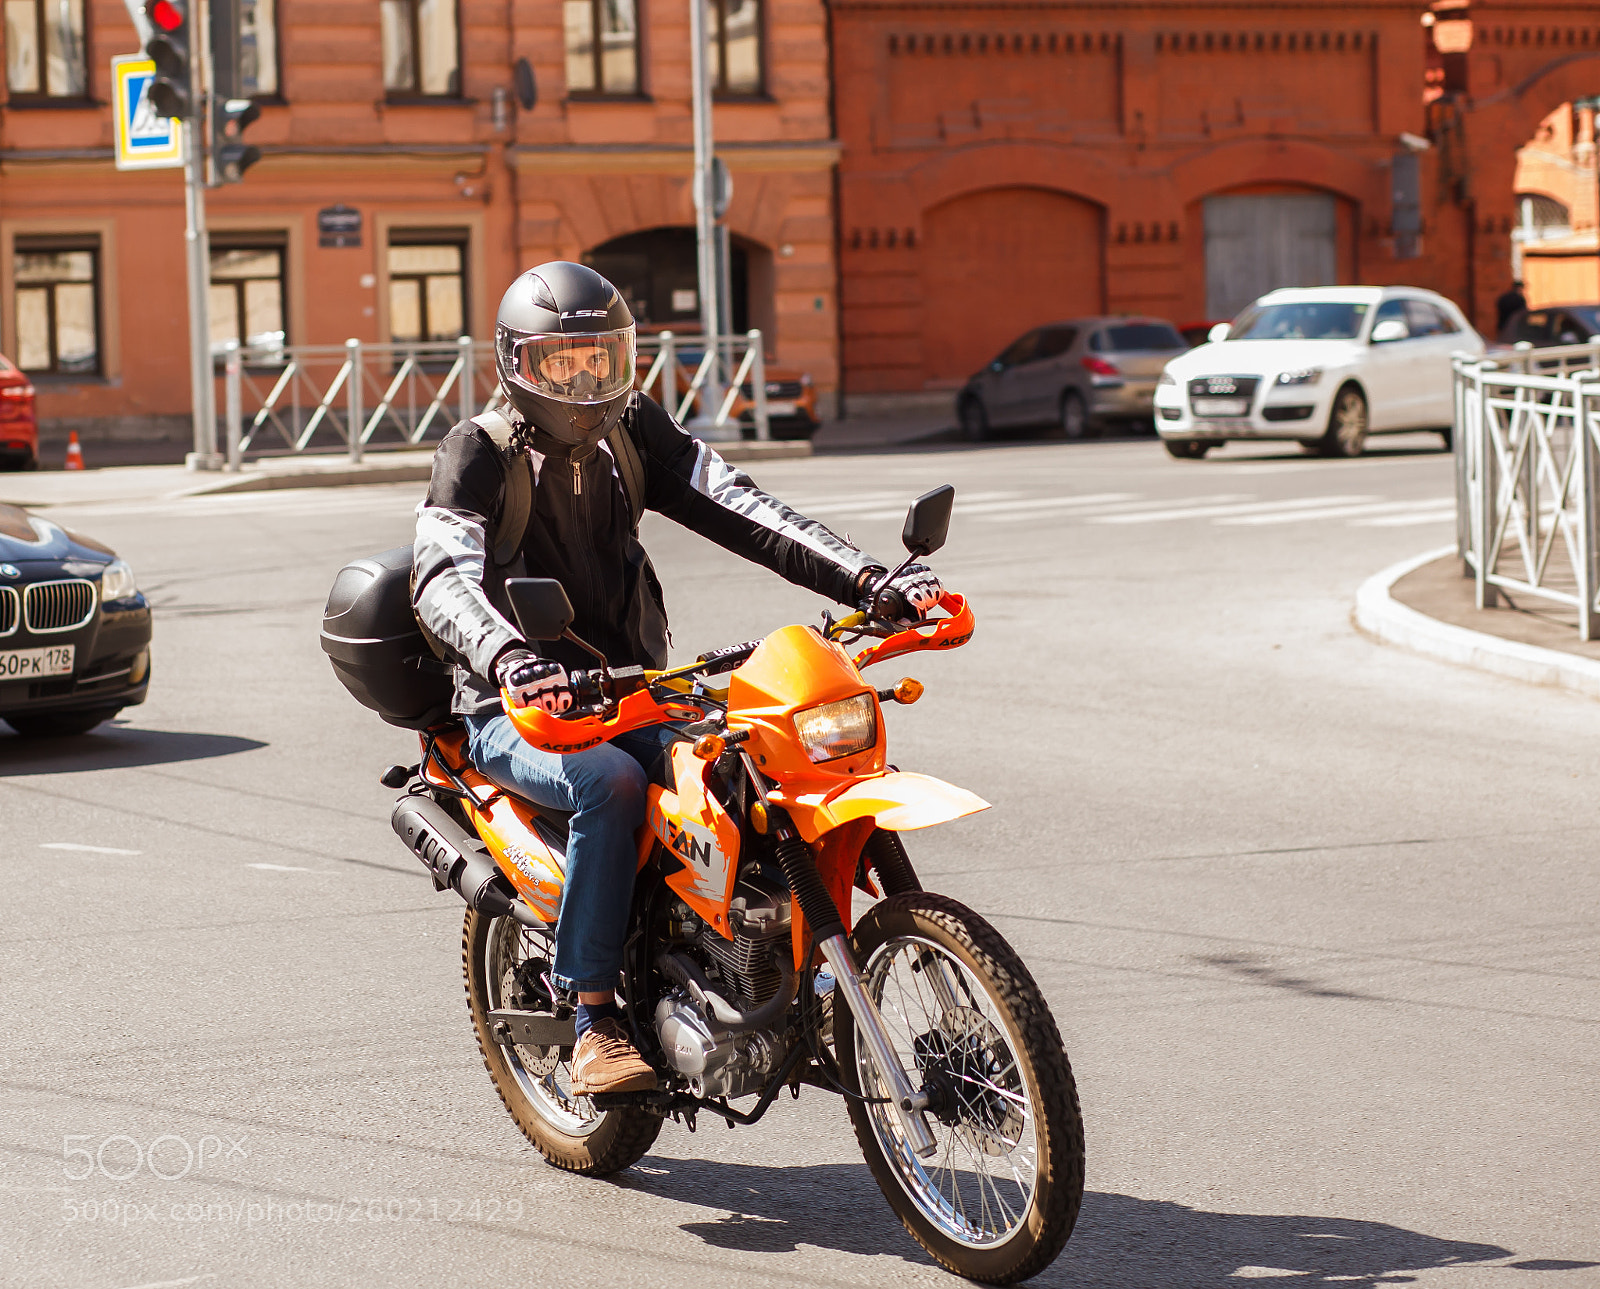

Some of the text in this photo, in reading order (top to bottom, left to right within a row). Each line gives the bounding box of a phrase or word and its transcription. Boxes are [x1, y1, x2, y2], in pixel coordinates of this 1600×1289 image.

[561, 309, 608, 320] LS2
[46, 648, 71, 665] 178
[650, 805, 712, 868] LIFAN
